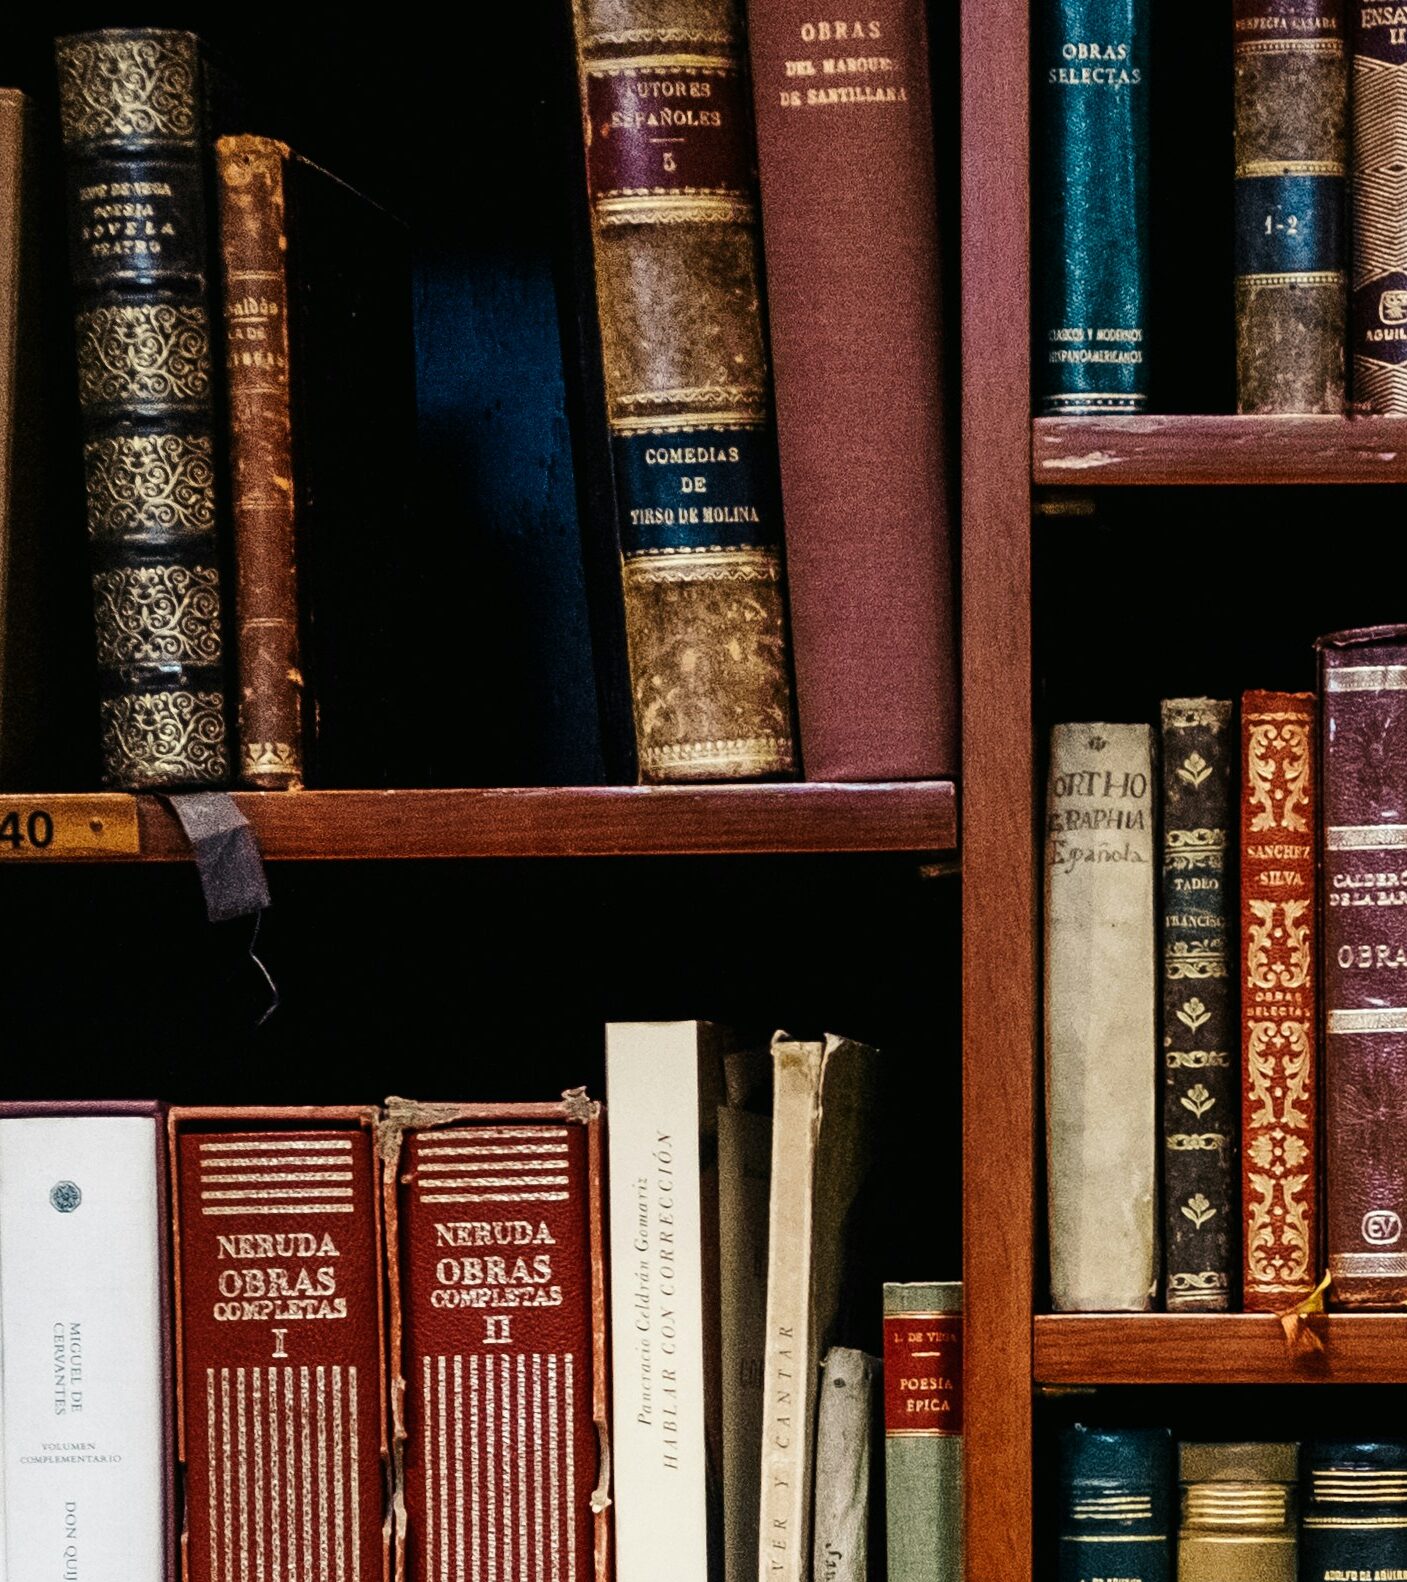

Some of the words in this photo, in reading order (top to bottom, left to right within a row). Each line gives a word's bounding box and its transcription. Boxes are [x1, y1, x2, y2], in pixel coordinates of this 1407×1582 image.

[801, 20, 881, 42] OBRAS
[1062, 43, 1127, 61] OBRAS
[1049, 67, 1141, 85] SELECTAS
[662, 152, 676, 172] 5
[645, 447, 739, 464] COMEDIAS
[681, 477, 706, 493] DE
[1258, 871, 1304, 886] SILVA
[656, 1130, 674, 1296] CORRECCIÓN
[217, 1233, 340, 1259] NERUDA
[433, 1220, 556, 1247] NERUDA
[217, 1266, 336, 1298] OBRAS
[435, 1254, 553, 1286] OBRAS
[212, 1297, 348, 1321] COMPLETAS
[430, 1285, 563, 1309] COMPLETAS
[272, 1328, 288, 1359] I
[660, 1306, 677, 1356] CON
[69, 1322, 83, 1383] MIGUEL
[52, 1322, 66, 1416] CERVANTES
[776, 1325, 795, 1451] CANTAR
[70, 1391, 83, 1412] DE
[663, 1364, 680, 1471] HABLAR
[775, 1476, 790, 1491] Y
[64, 1501, 77, 1540] DON
[772, 1517, 789, 1573] VER
